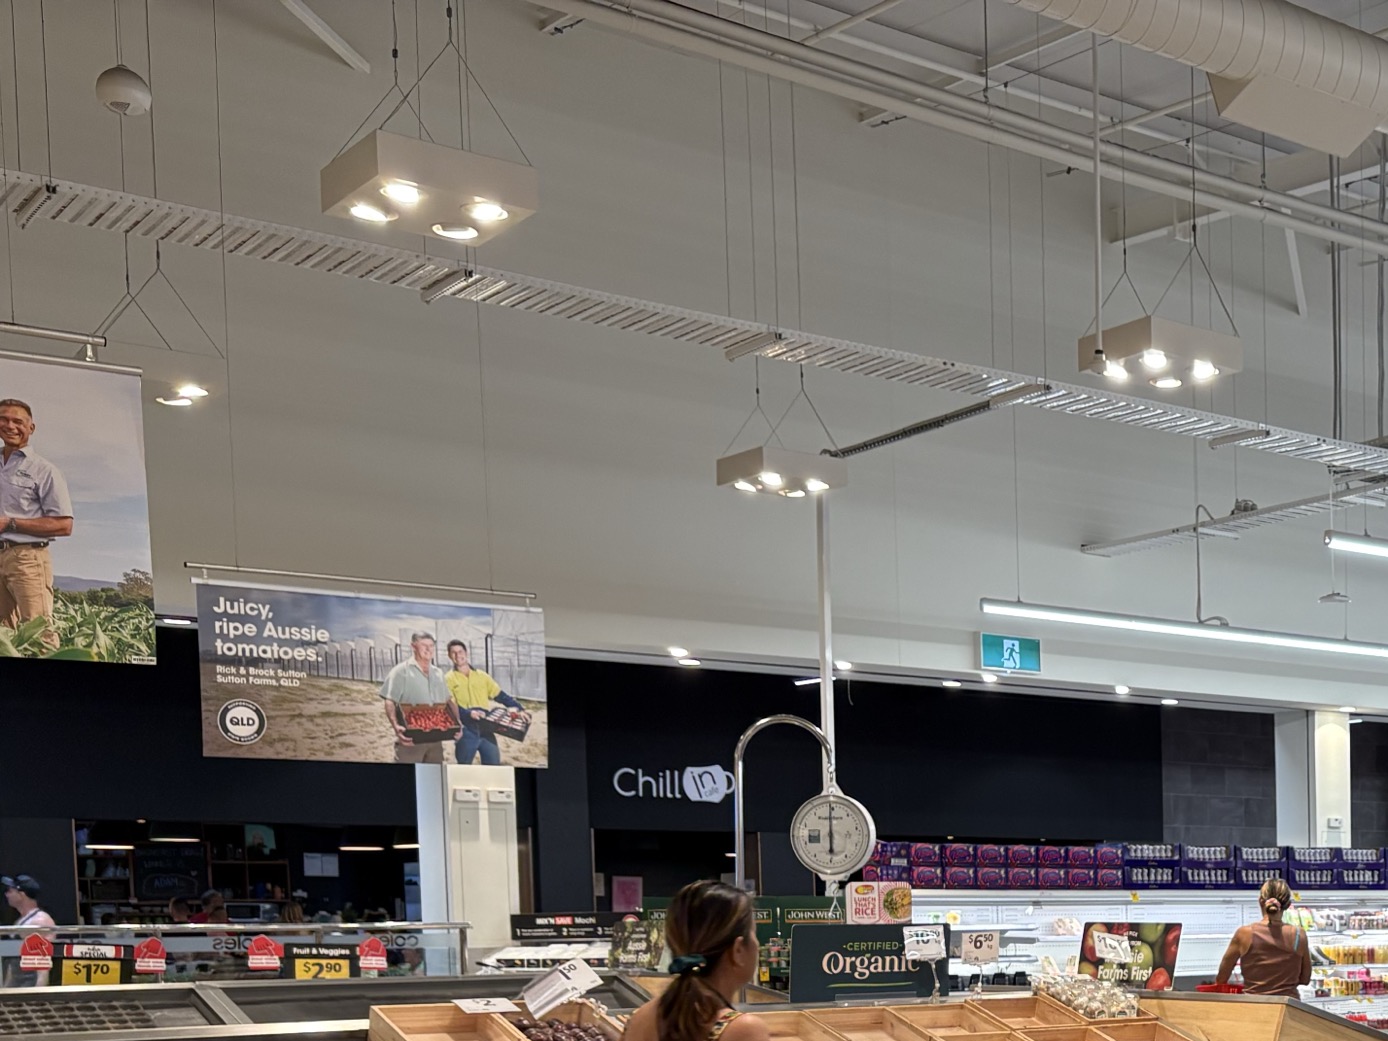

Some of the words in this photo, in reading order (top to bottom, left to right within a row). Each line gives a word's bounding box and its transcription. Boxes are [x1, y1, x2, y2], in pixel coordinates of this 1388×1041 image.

[213, 597, 273, 620] Juicy,
[214, 618, 257, 639] ripe
[263, 621, 330, 642] Aussie
[215, 638, 322, 662] tomatoes.
[216, 665, 236, 674] Rick
[239, 667, 247, 675] &
[249, 667, 275, 677] Brock
[277, 669, 307, 679] Sutton
[216, 675, 247, 684] Sutton
[249, 677, 279, 686] Farms,
[280, 678, 300, 687] QLD
[229, 716, 256, 726] QLD
[613, 767, 682, 799] Chill
[690, 771, 717, 799] in
[651, 911, 666, 919] JO
[752, 911, 769, 919] EST
[788, 911, 814, 920] JOHN
[855, 908, 875, 916] RICE
[555, 916, 573, 925] SAVE
[574, 917, 597, 925] Mochi
[562, 927, 568, 936] 2
[596, 926, 602, 935] 3
[847, 942, 898, 951] CERTIFIED
[293, 947, 310, 955] Fruit
[319, 947, 350, 956] Veggies
[822, 951, 920, 980] Organic
[1097, 965, 1128, 980] Farms
[1131, 966, 1152, 981] First
